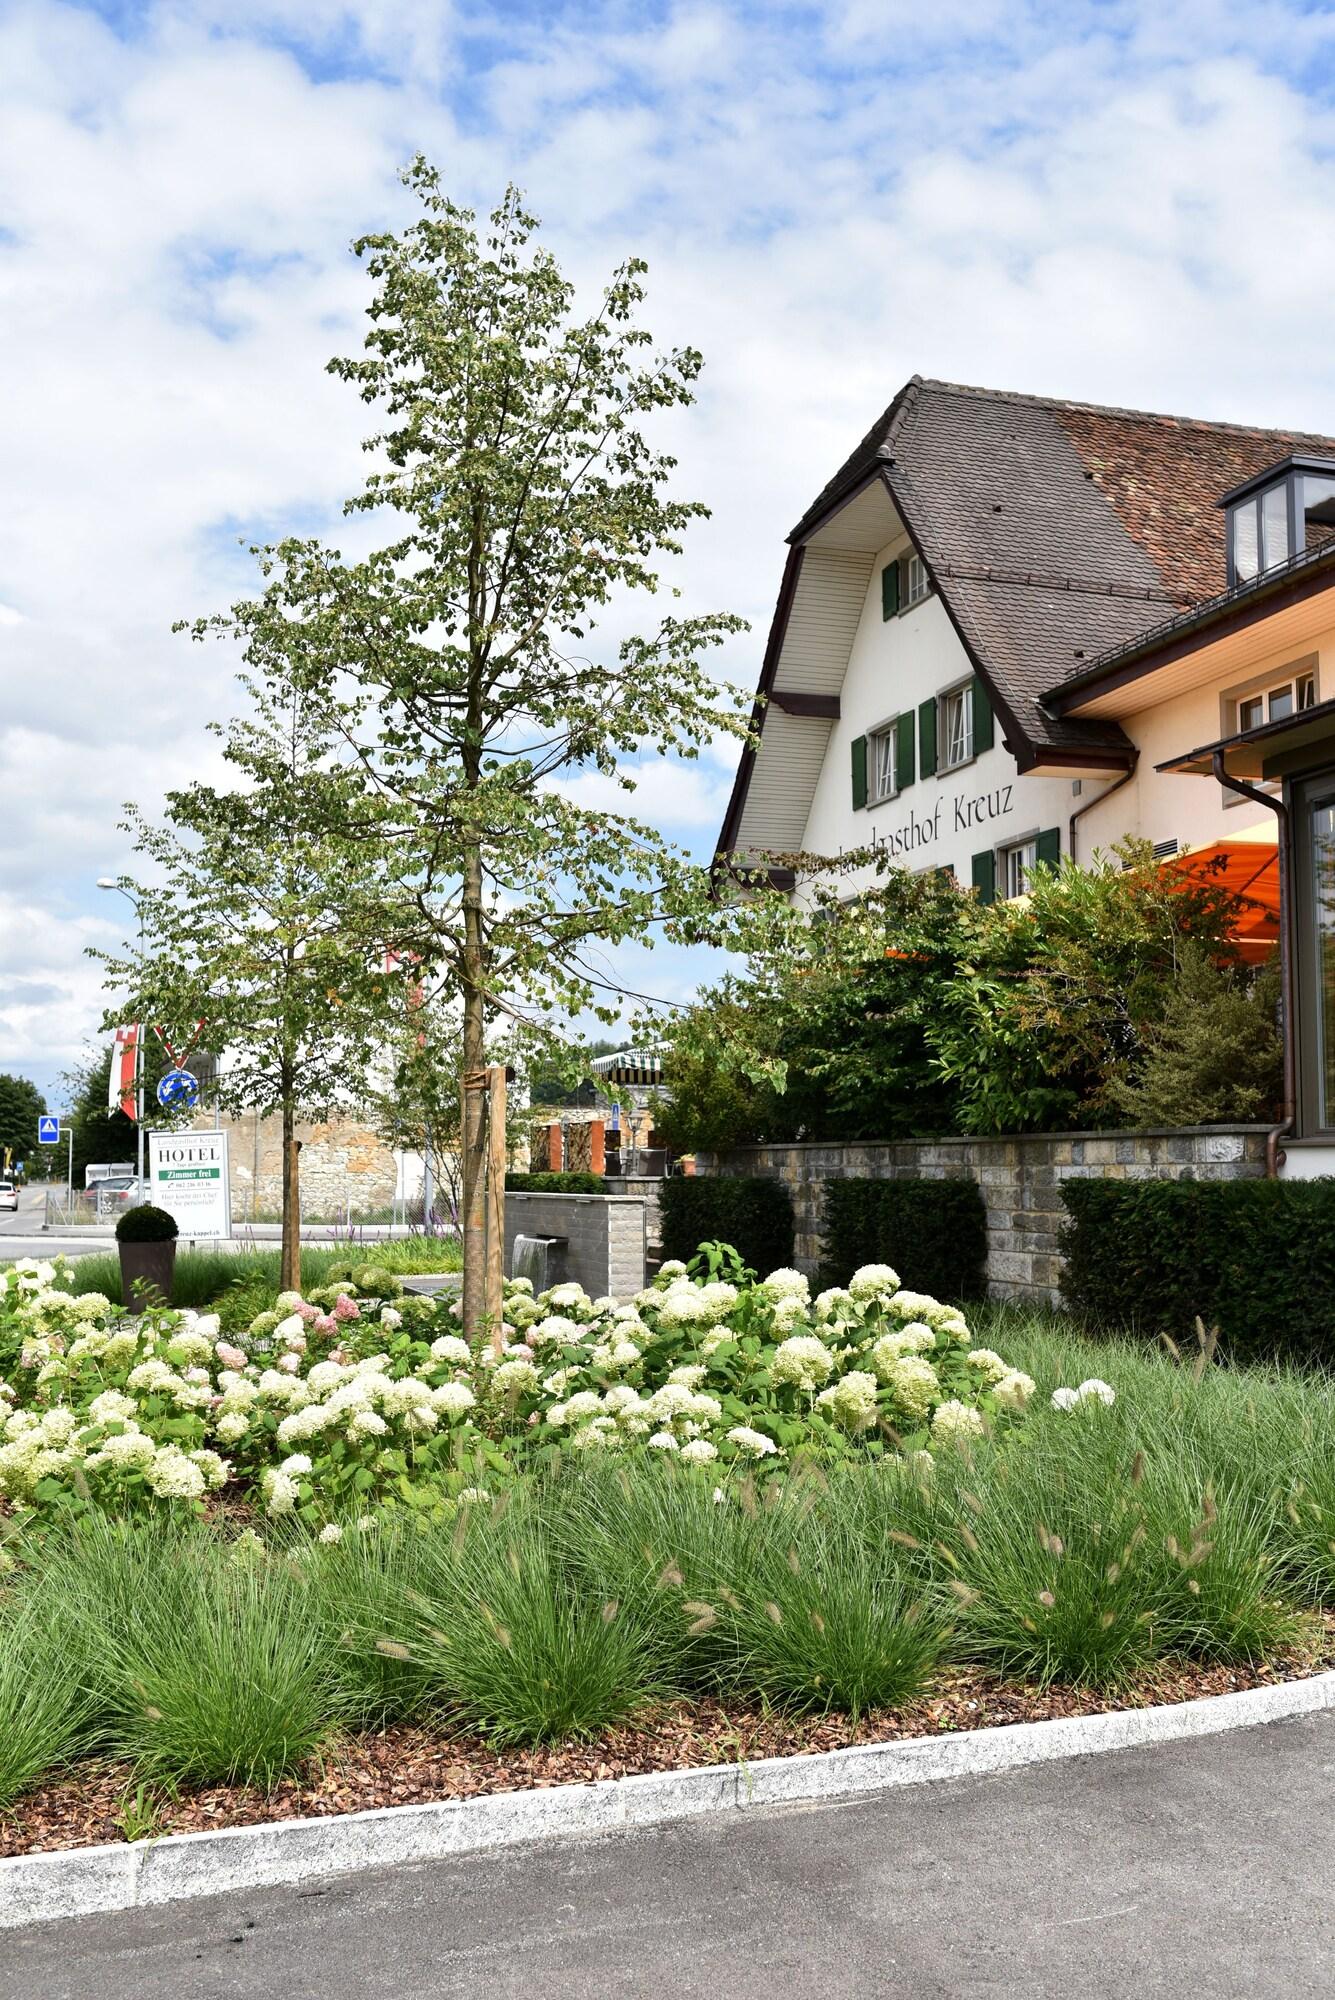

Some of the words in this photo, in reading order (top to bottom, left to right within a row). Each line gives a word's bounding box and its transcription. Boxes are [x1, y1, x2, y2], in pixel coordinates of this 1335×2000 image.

[839, 796, 943, 876] Ldasthof
[954, 784, 1013, 833] Kreuz
[159, 1147, 220, 1162] HOTEL
[167, 1171, 197, 1179] Zimmer
[198, 1169, 212, 1178] frei
